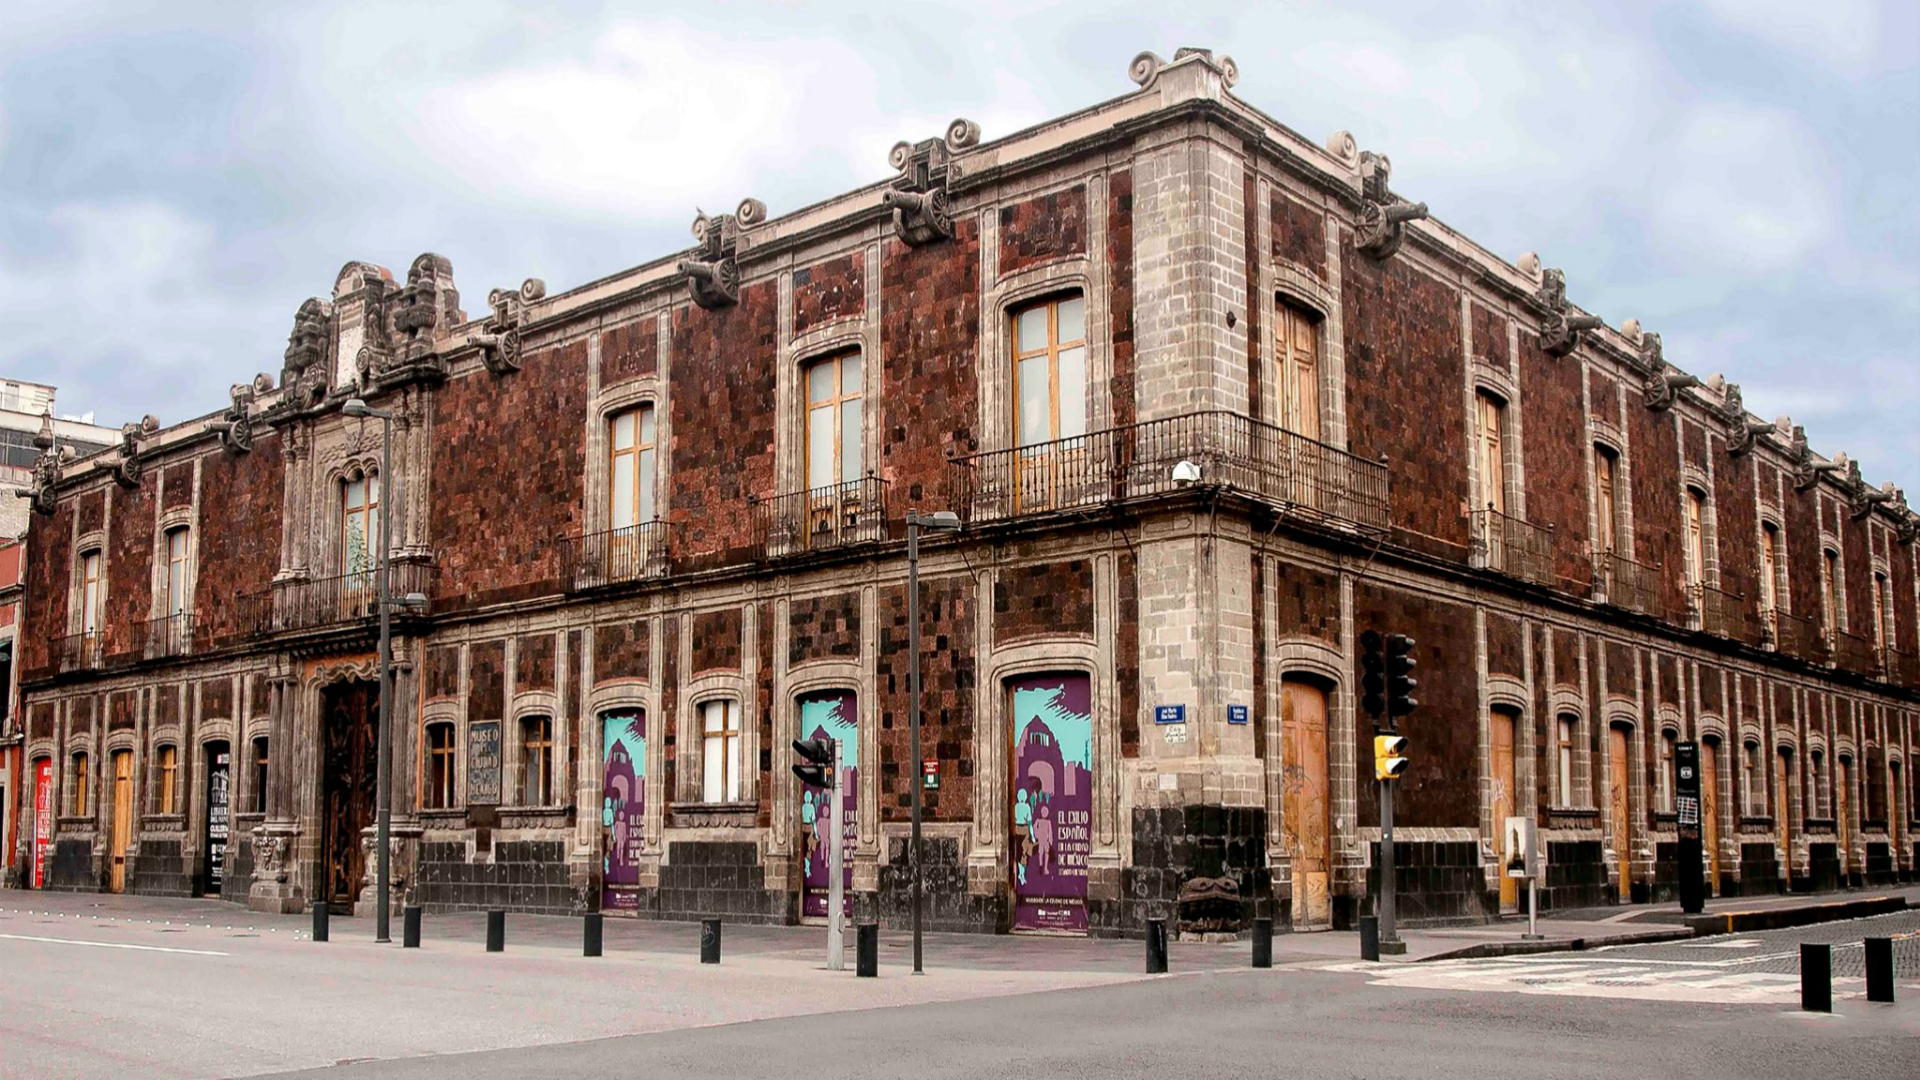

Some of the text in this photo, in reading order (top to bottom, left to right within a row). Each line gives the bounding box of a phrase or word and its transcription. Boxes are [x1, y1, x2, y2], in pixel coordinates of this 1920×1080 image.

[471, 729, 499, 742] MUSEO
[471, 756, 498, 769] CIUDAD
[1058, 810, 1088, 825] EL EXILIO
[1058, 825, 1089, 840] ESPAÑOL
[1058, 852, 1089, 866] DE MÉXICO
